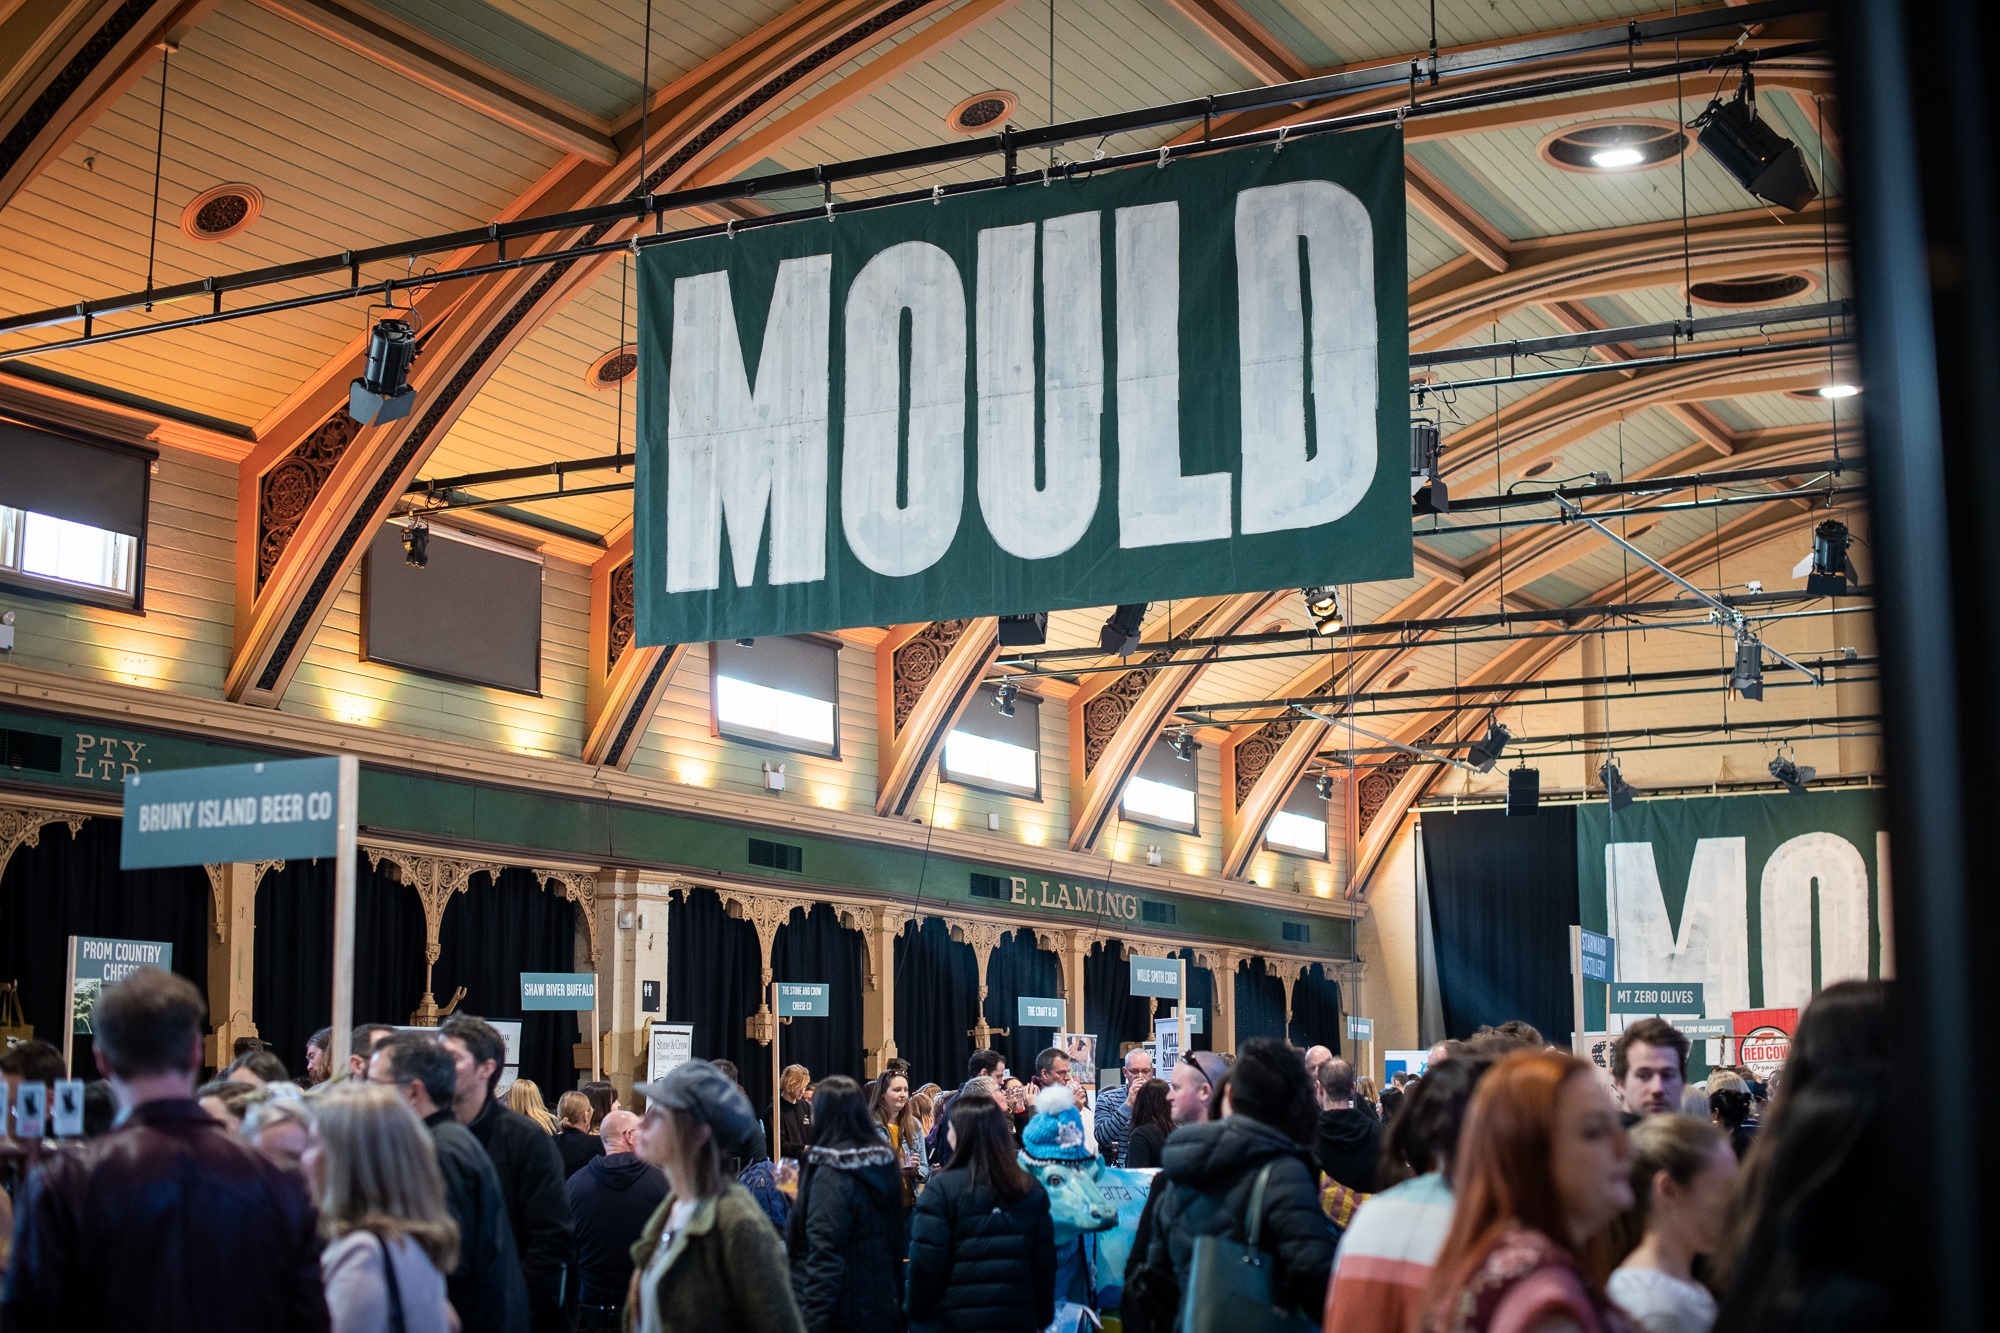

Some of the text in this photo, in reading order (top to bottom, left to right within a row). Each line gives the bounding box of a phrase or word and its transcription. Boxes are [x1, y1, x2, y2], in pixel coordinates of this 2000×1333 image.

[667, 180, 1379, 593] MOULD
[75, 734, 152, 764] PTY.
[138, 790, 333, 833] BRUNY ISLAND BEER CO
[1581, 932, 1607, 957] STARWARD
[83, 940, 161, 964] PROM COUNTRY
[1582, 954, 1607, 979] DISTILLERY
[1136, 968, 1178, 985] WILLIE SMITH CIDER
[524, 983, 594, 997] SHAW RIVER BUFFALO
[782, 986, 822, 996] THE STONE AND CROW
[1617, 990, 1694, 1004] MT ZERO OLIVES
[792, 1001, 812, 1011] CHEESE CO
[1027, 1005, 1036, 1017] THE
[1685, 1025, 1697, 1033] COW
[1698, 1024, 1726, 1034] ORGANICS
[656, 1038, 671, 1050] Stone
[1162, 1033, 1179, 1050] WILL
[1744, 1047, 1764, 1061] RED
[1752, 1063, 1784, 1073] Organic
